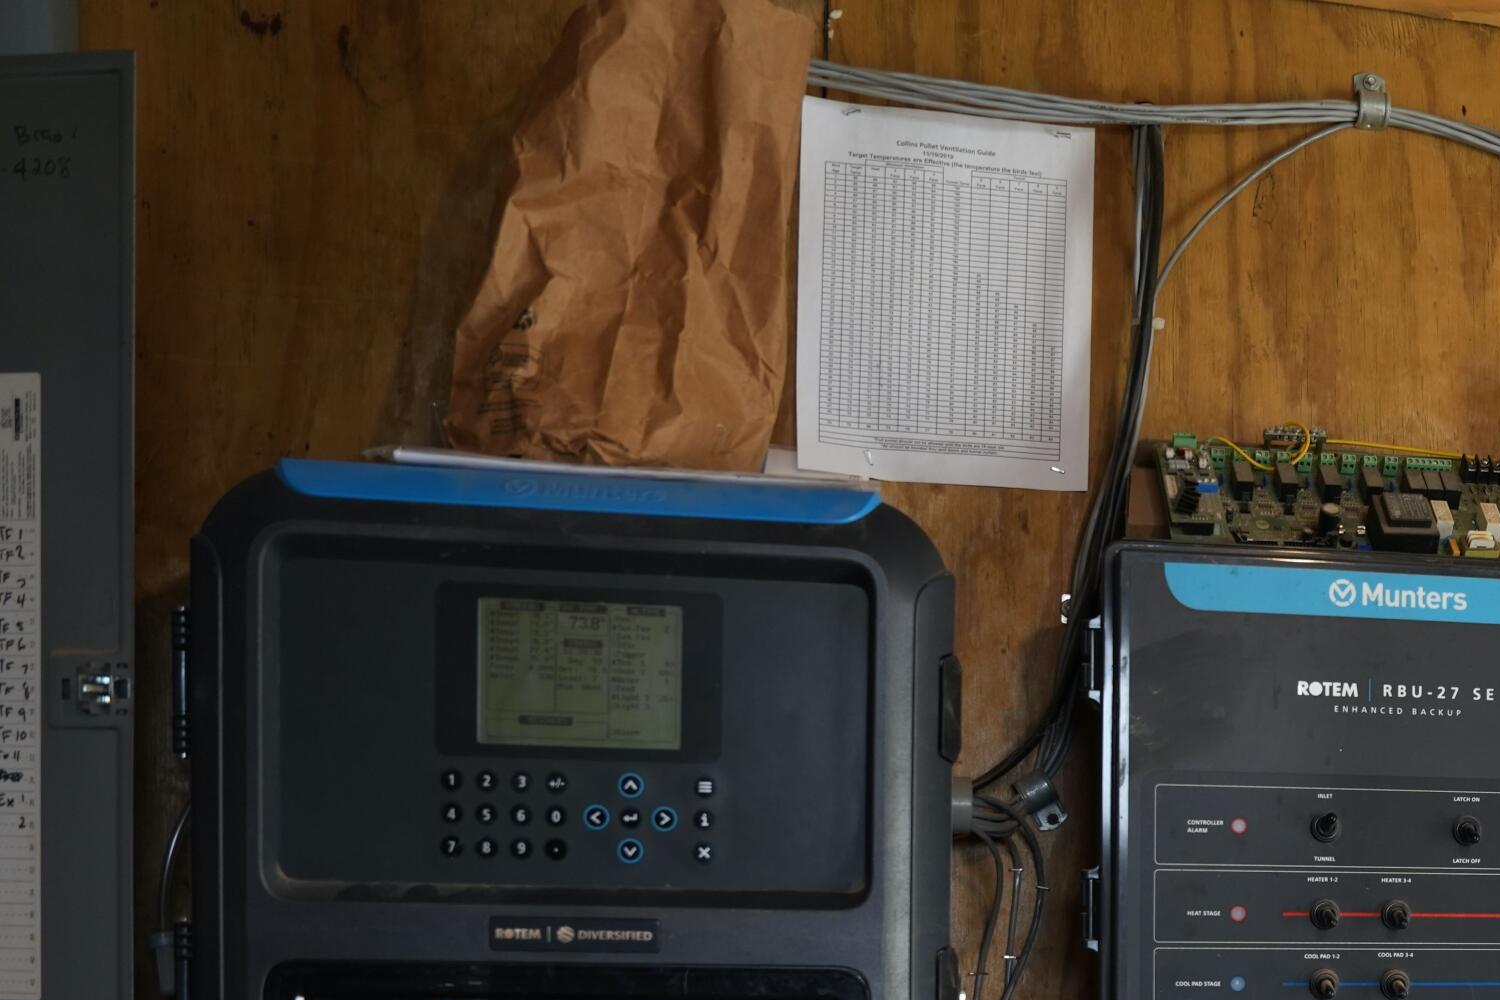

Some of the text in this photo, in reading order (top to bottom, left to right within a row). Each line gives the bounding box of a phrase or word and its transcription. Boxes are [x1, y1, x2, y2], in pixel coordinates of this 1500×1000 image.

[896, 139, 918, 148] Collins
[939, 144, 976, 155] Ventilation
[977, 149, 997, 157] Guide
[848, 151, 869, 160] Target
[869, 153, 912, 163] Temperatures
[923, 158, 950, 168] Effective
[1361, 581, 1468, 611] Munters
[1297, 680, 1495, 701] ROTEM RBU-27 SE
[1334, 704, 1463, 718] ENHANCED BACKUP
[16, 730, 27, 742] 10
[449, 773, 455, 786] 1
[482, 774, 491, 787] 2
[518, 775, 527, 788] 3
[447, 807, 456, 820] 4
[482, 808, 491, 821] 5
[516, 809, 525, 822] 6
[551, 810, 561, 822] 0
[18, 816, 25, 829] 2
[447, 840, 456, 853] 7
[482, 841, 491, 854] 8
[517, 841, 526, 854] 9
[494, 927, 653, 942] ROTEM DIVERSIFIED
